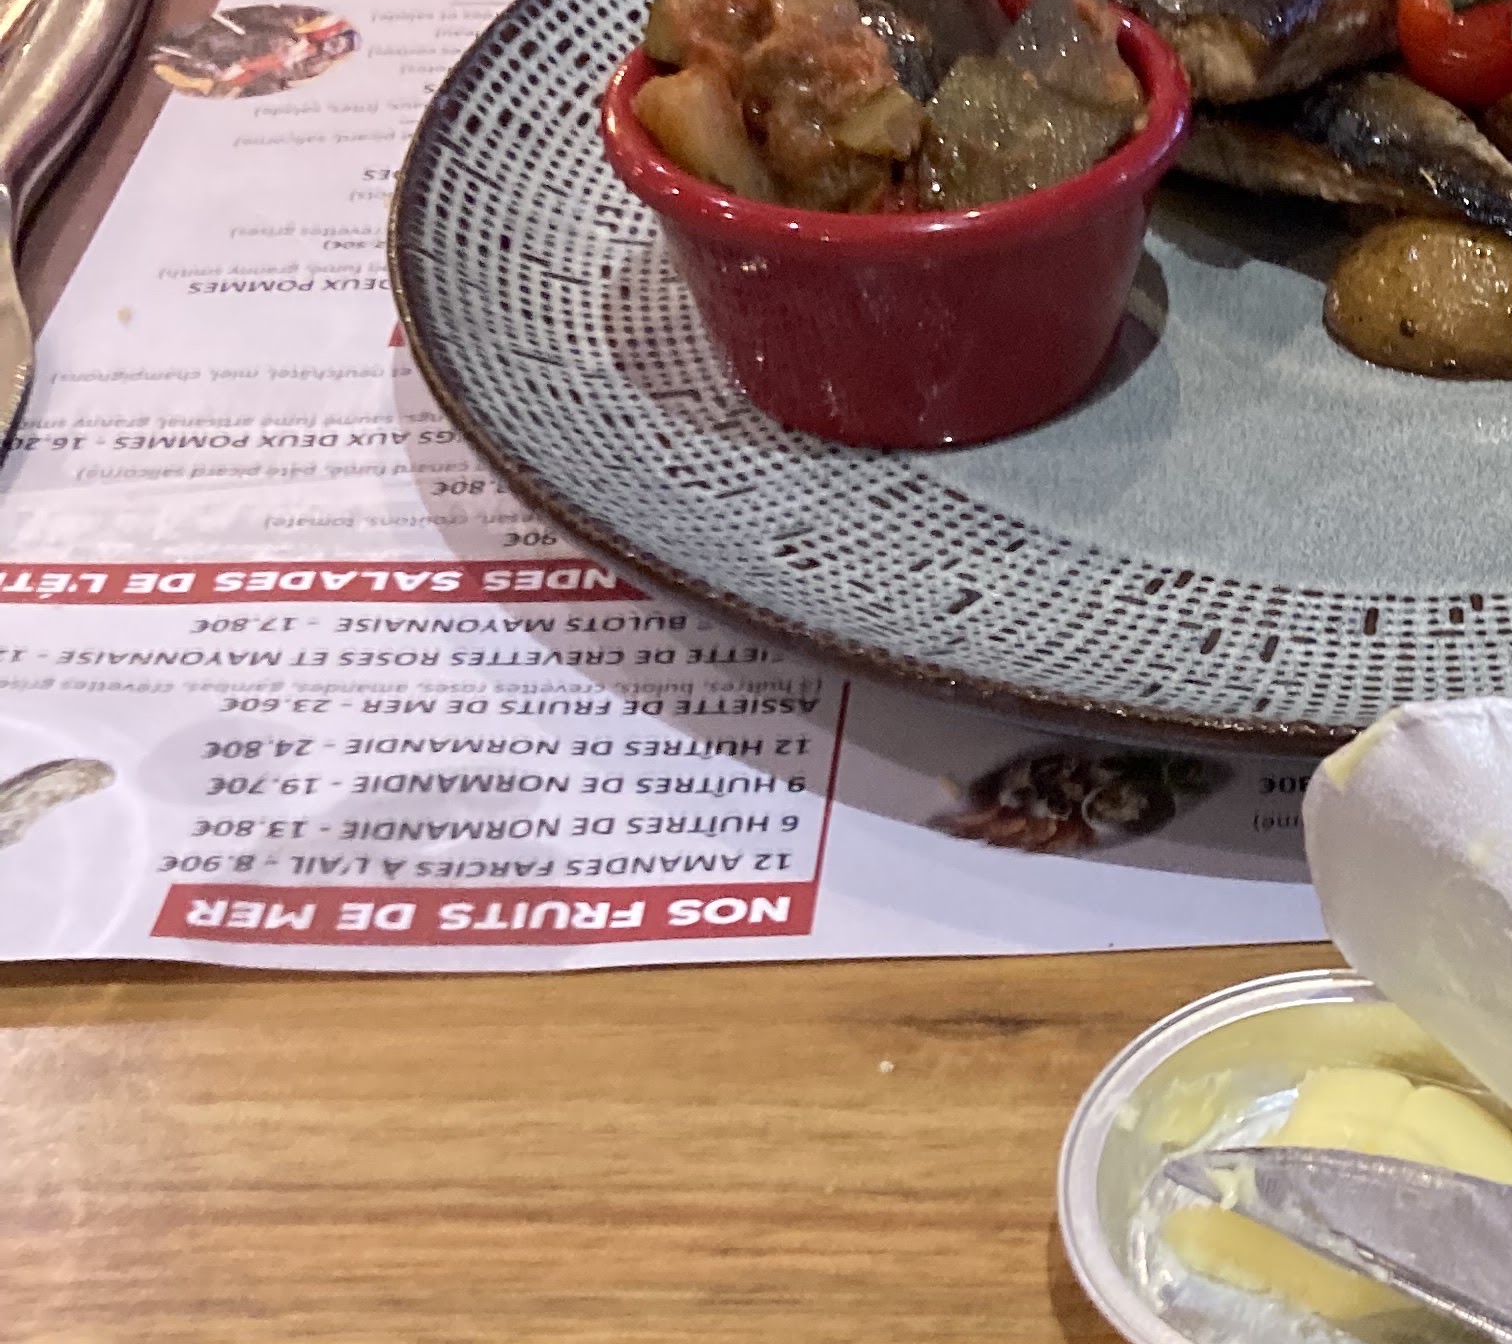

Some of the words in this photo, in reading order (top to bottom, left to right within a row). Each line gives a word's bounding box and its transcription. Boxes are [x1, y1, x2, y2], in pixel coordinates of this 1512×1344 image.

[188, 279, 315, 294] POMMES
[113, 435, 250, 450] POMMES
[257, 434, 339, 449] DEUX
[346, 433, 412, 447] AUX
[0, 572, 109, 599] L'ÉT
[123, 572, 196, 594] DE
[212, 570, 464, 592] SALADES
[189, 617, 298, 634] 17.80€
[335, 617, 555, 633] MAYONNAISE
[565, 616, 687, 633] BULOTS
[56, 651, 283, 666] MAYONNAISE
[290, 652, 328, 666] ET
[339, 651, 440, 666] ROSES
[451, 650, 624, 666] CREVETTES
[634, 650, 676, 664] DE
[219, 698, 333, 713] 23.60€
[362, 699, 436, 714] MER
[447, 699, 488, 714] DE
[500, 699, 612, 715] FRUITS
[622, 699, 664, 715] DE
[674, 698, 821, 715] ASSIETTE
[204, 739, 313, 758] 24.80€
[343, 739, 560, 756] NORMANDIE
[570, 740, 613, 756] DE
[623, 739, 764, 761] HUÎTRES
[776, 739, 811, 756] 12
[206, 777, 321, 795] 19.70€
[352, 774, 570, 795] NORMANDIE
[581, 777, 624, 794] DE
[636, 777, 775, 797] HUÎTRES
[787, 776, 806, 793] 9
[190, 820, 309, 839] 13.80€
[338, 819, 561, 840] NORMANDIE
[571, 817, 616, 836] DE
[627, 816, 770, 838] HUÎTRES
[781, 816, 799, 834] 6
[157, 855, 255, 873] 8.90€
[291, 855, 368, 877] L'AIL
[382, 859, 407, 881] À
[416, 860, 555, 878] FARCIES
[567, 854, 744, 876] AMANDES
[753, 853, 792, 871] 12
[184, 900, 317, 929] MER
[336, 903, 417, 931] DE
[437, 901, 645, 930] FRUITS
[667, 896, 791, 926] NOS
